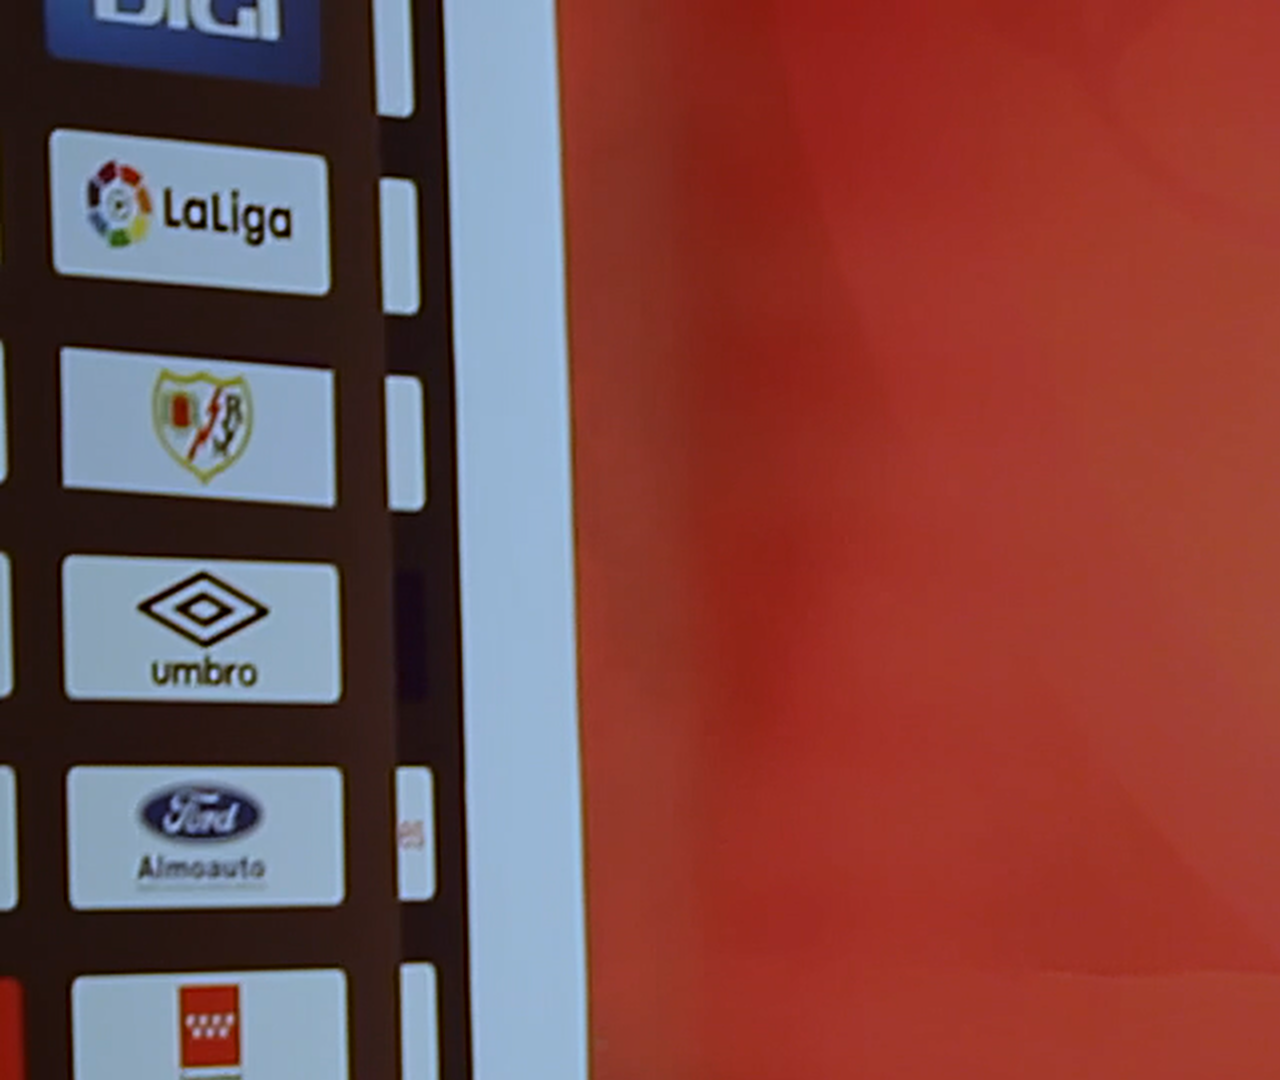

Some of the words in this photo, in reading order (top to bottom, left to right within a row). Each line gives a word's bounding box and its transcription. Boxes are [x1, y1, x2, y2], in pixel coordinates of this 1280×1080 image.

[95, 0, 281, 41] DIGI
[162, 188, 293, 247] LaLiga
[150, 657, 259, 687] umbro
[163, 793, 239, 833] Ford
[137, 855, 266, 880] Almoauto
